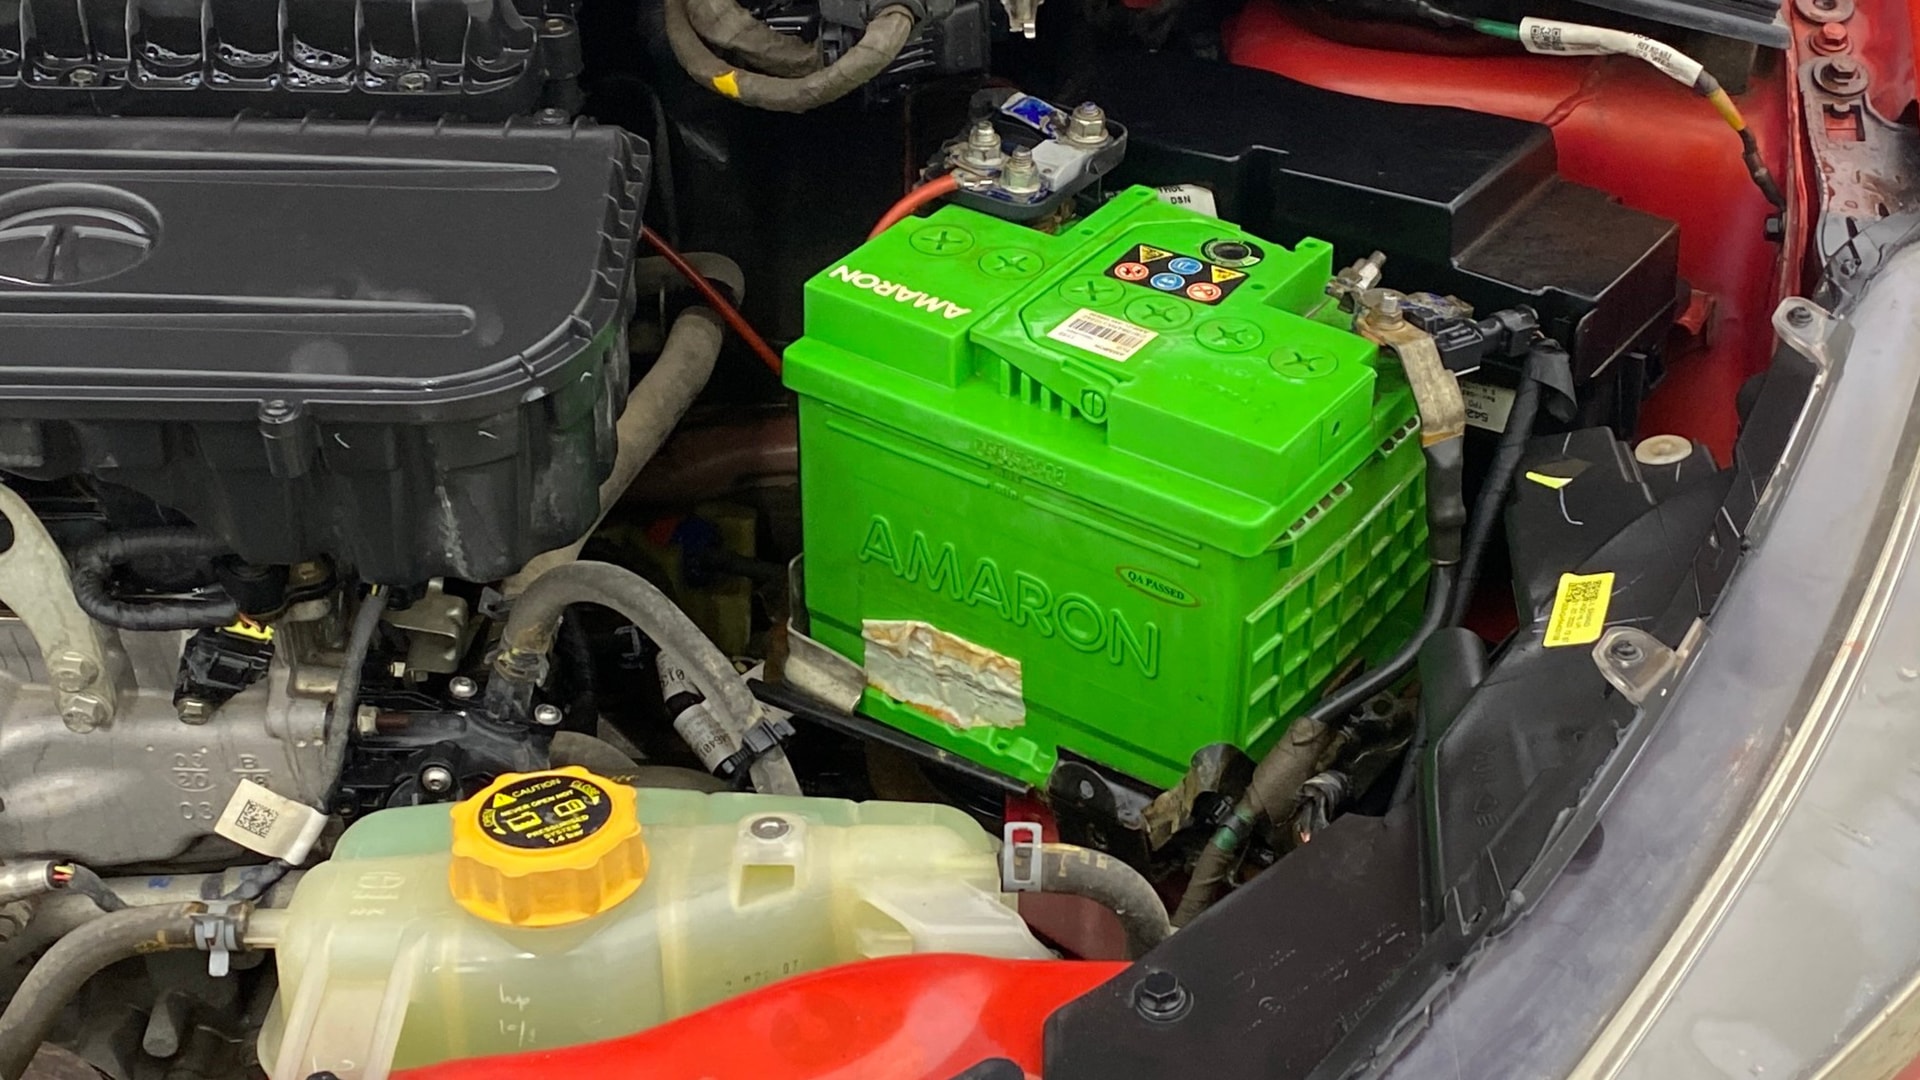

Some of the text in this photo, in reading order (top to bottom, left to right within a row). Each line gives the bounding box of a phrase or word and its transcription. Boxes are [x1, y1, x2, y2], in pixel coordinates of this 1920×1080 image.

[829, 265, 972, 319] AMARON
[859, 514, 1160, 679] AMARON
[1127, 571, 1185, 600] QA PASSED
[512, 779, 561, 797] CAUTION
